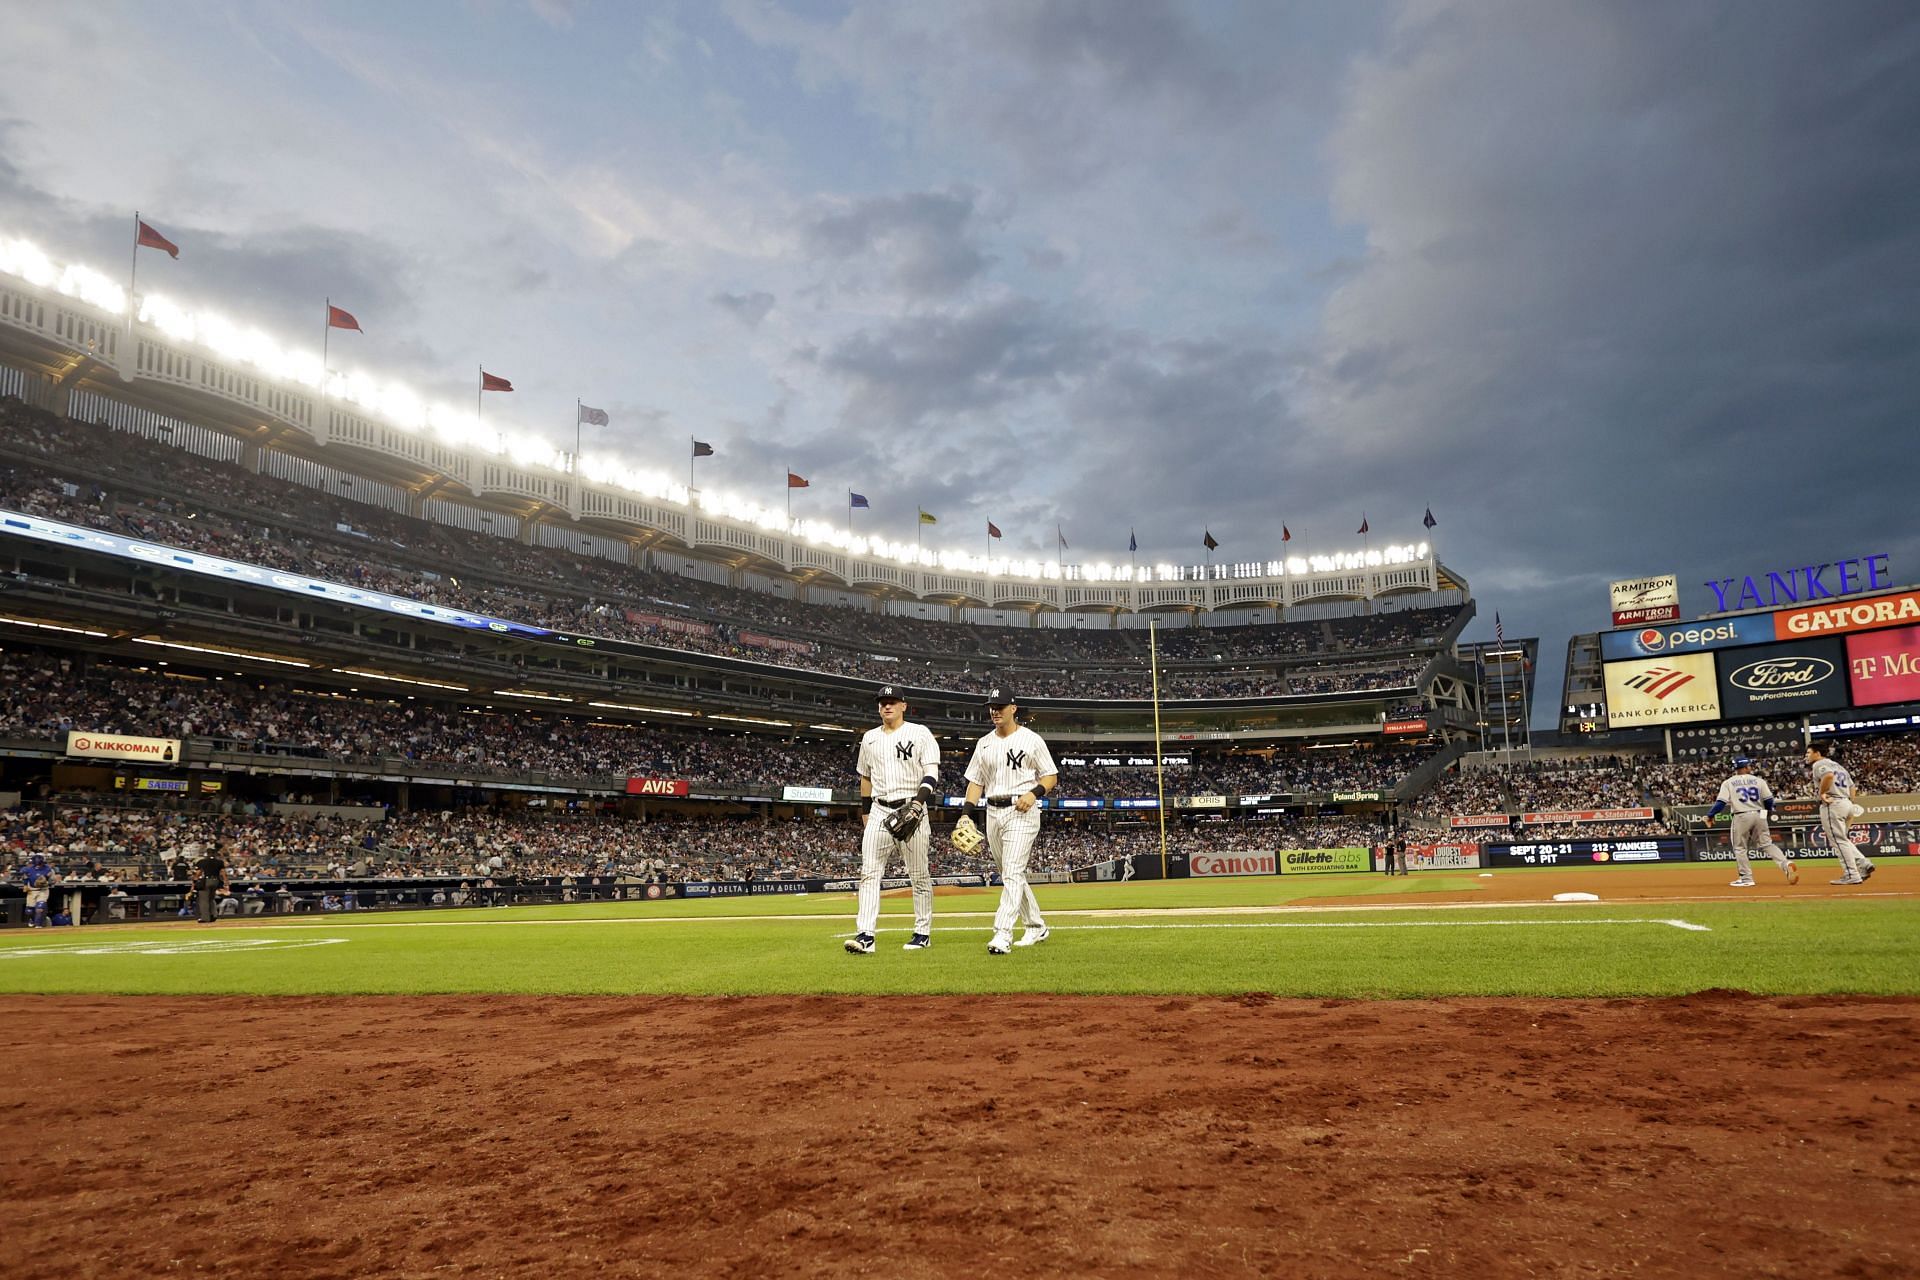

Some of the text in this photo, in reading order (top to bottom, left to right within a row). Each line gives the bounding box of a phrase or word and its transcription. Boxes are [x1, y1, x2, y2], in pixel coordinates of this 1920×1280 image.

[1613, 579, 1673, 593] ARMITRON
[1704, 554, 1892, 612] YANKEE
[1619, 607, 1674, 620] ARMITRON
[1788, 598, 1920, 633] GATORA
[661, 618, 685, 633] PARTY
[1670, 622, 1734, 648] pepsi
[1748, 661, 1815, 687] Ford
[1749, 689, 1818, 702] BuyFordNow.com
[1610, 710, 1641, 719] BANK
[1644, 708, 1659, 716] OF
[1662, 703, 1716, 715] AMERICA
[94, 742, 160, 754] KIKKOMAN
[896, 740, 915, 760] NY
[1006, 749, 1026, 770] NY
[147, 780, 187, 791] SABRET
[642, 780, 674, 794] AVIS
[791, 788, 825, 799] StubHub
[1333, 791, 1379, 801] Poland Spring
[1736, 786, 1760, 803] 39
[1198, 796, 1220, 804] ORIS
[1867, 805, 1900, 813] LOTTE
[1687, 814, 1709, 823] Ube
[1510, 845, 1536, 855] SEPT
[1592, 844, 1609, 852] 212
[1616, 841, 1658, 851] YANKEES
[1800, 846, 1839, 857] StubHu
[1880, 845, 1896, 853] 399
[1540, 854, 1558, 864] PIT
[1700, 851, 1737, 860] StubHu
[1191, 856, 1275, 875] Canon
[686, 885, 709, 893] GEICO
[718, 885, 743, 893] DELTA
[753, 884, 775, 892] DELTA
